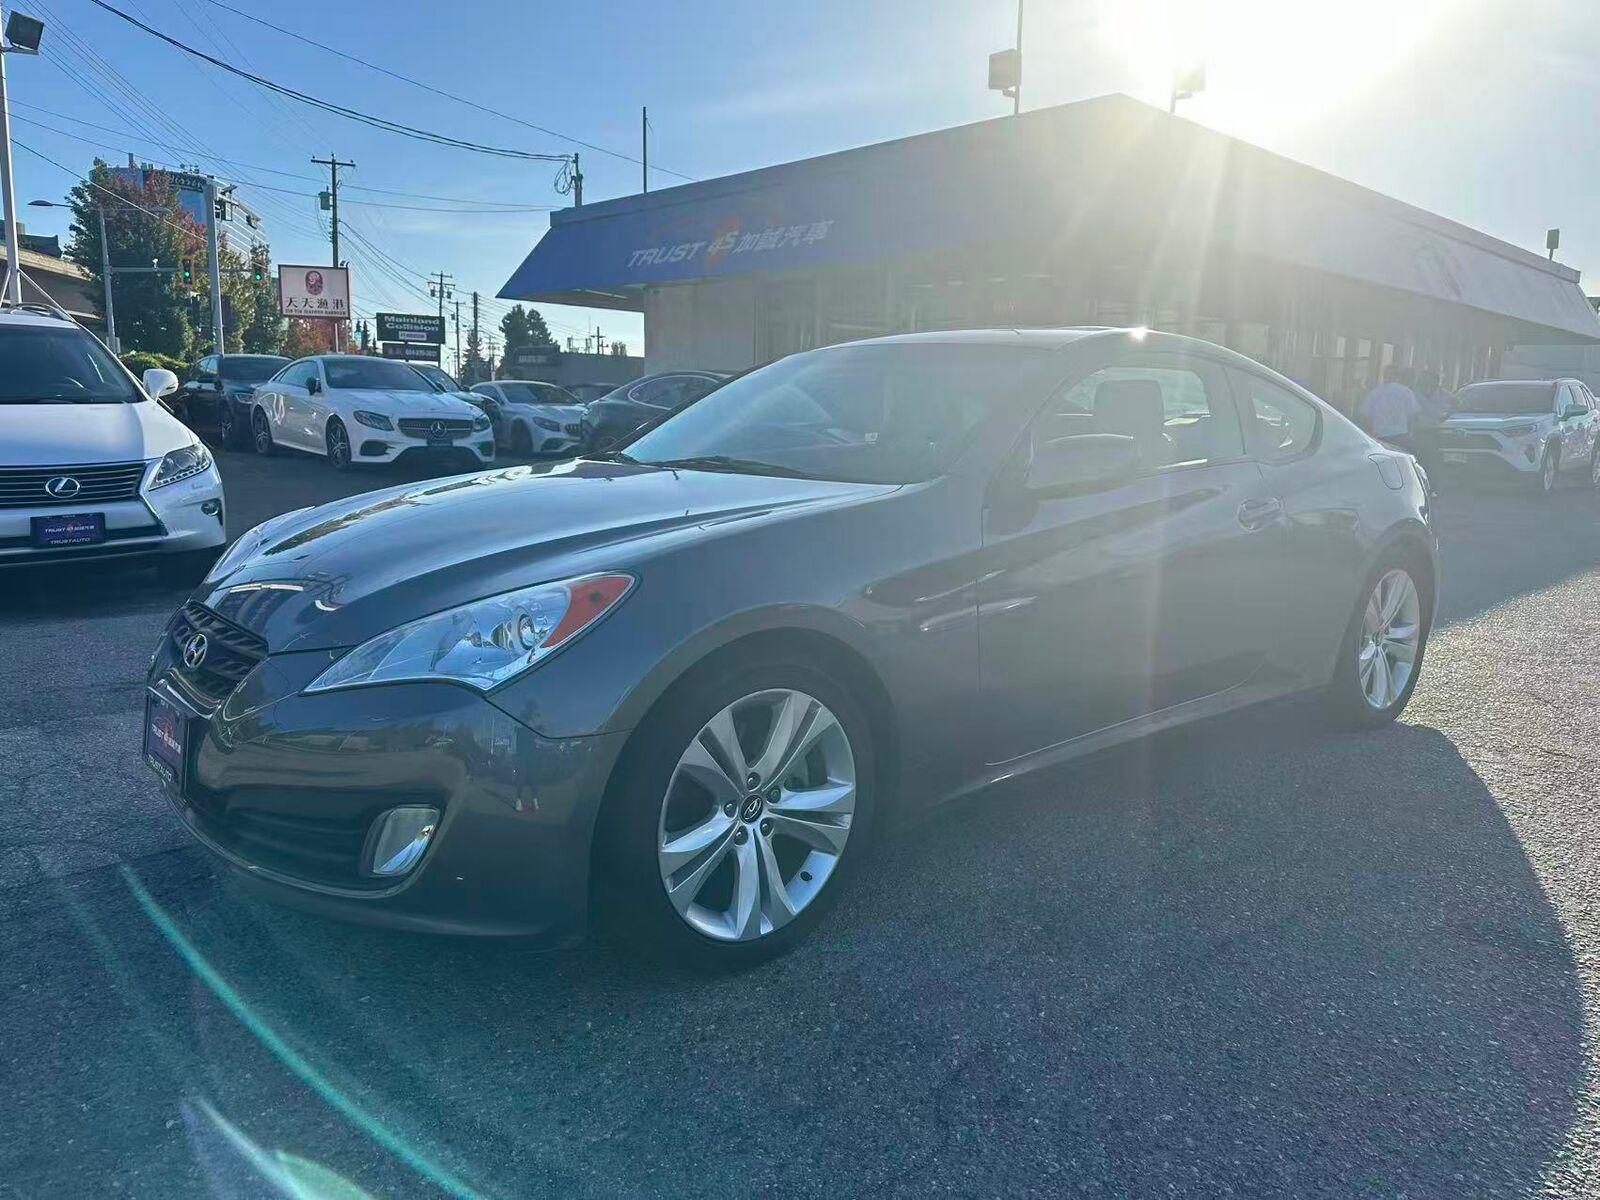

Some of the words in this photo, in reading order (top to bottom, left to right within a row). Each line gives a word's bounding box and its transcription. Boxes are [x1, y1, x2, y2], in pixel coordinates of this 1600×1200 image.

[627, 240, 707, 267] TRUST
[384, 315, 440, 325] Mainland
[386, 322, 439, 331] Collision
